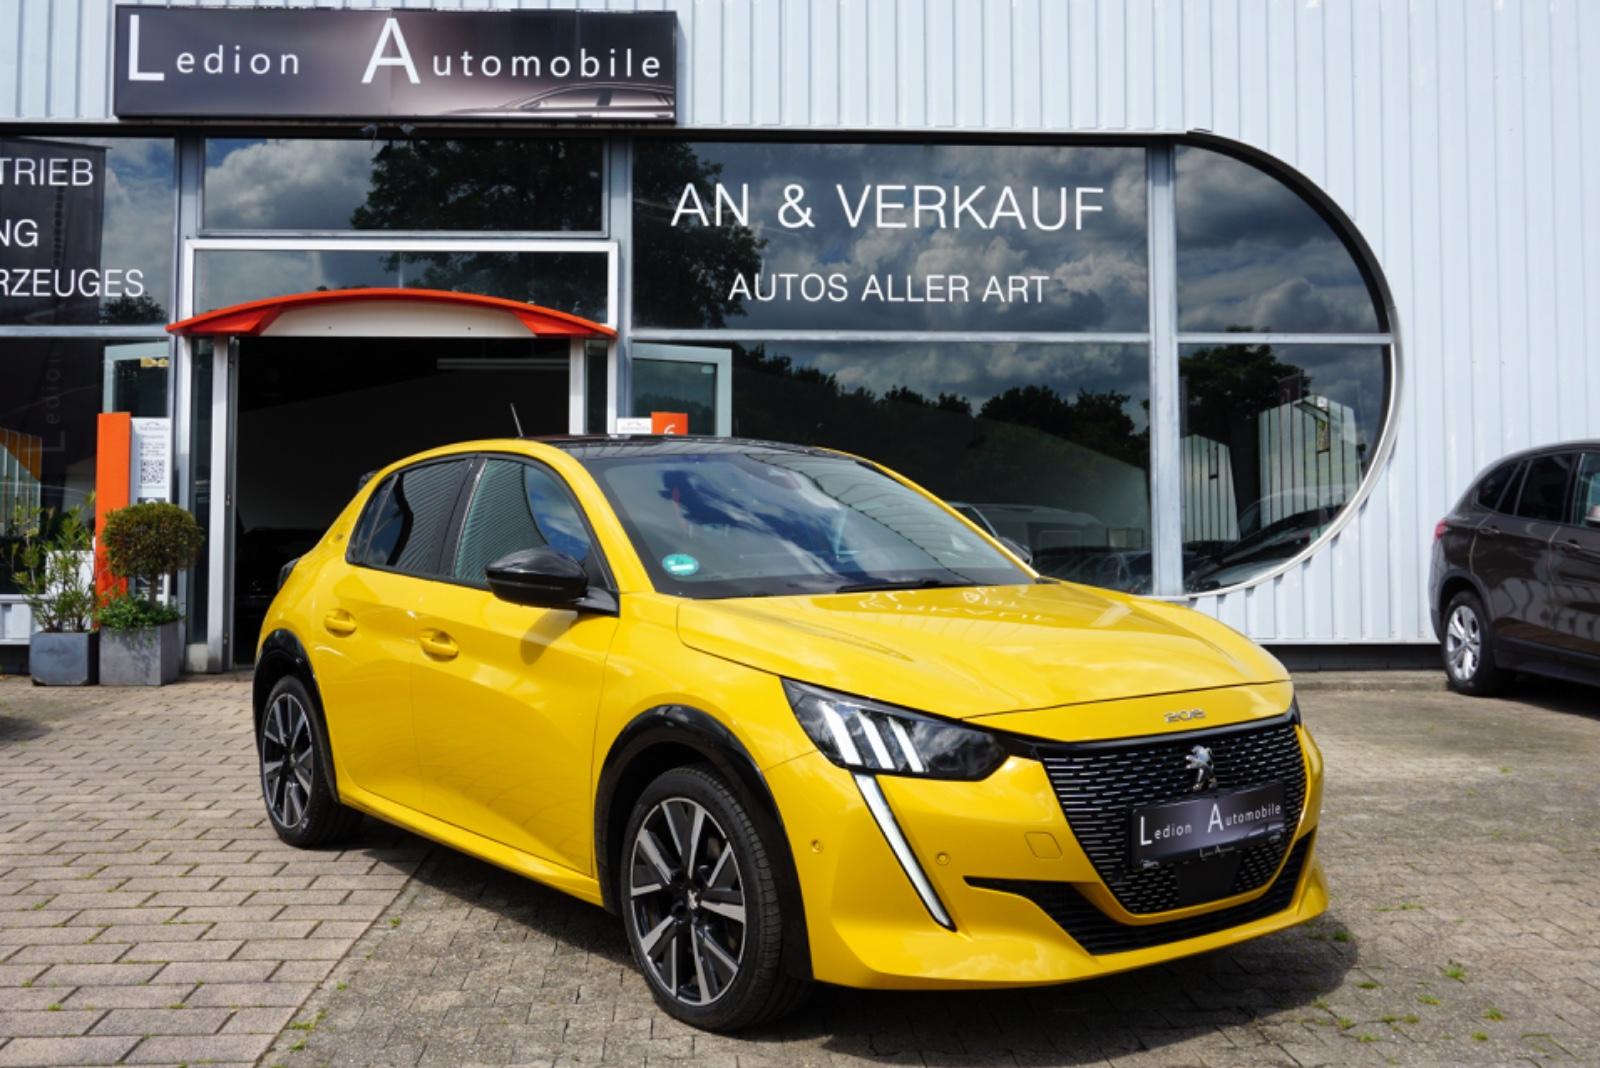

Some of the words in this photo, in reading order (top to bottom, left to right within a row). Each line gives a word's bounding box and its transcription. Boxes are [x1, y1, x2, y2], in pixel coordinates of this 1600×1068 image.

[128, 14, 299, 82] Ledion
[362, 17, 660, 84] Automobile
[671, 182, 749, 227] AN
[777, 183, 815, 229] &
[836, 184, 1104, 231] VERKAUF
[728, 273, 848, 302] AUTOS
[861, 274, 969, 303] ALLER
[982, 275, 1050, 303] ART
[1140, 815, 1193, 846] Ledion
[1207, 803, 1282, 834] Automobile
